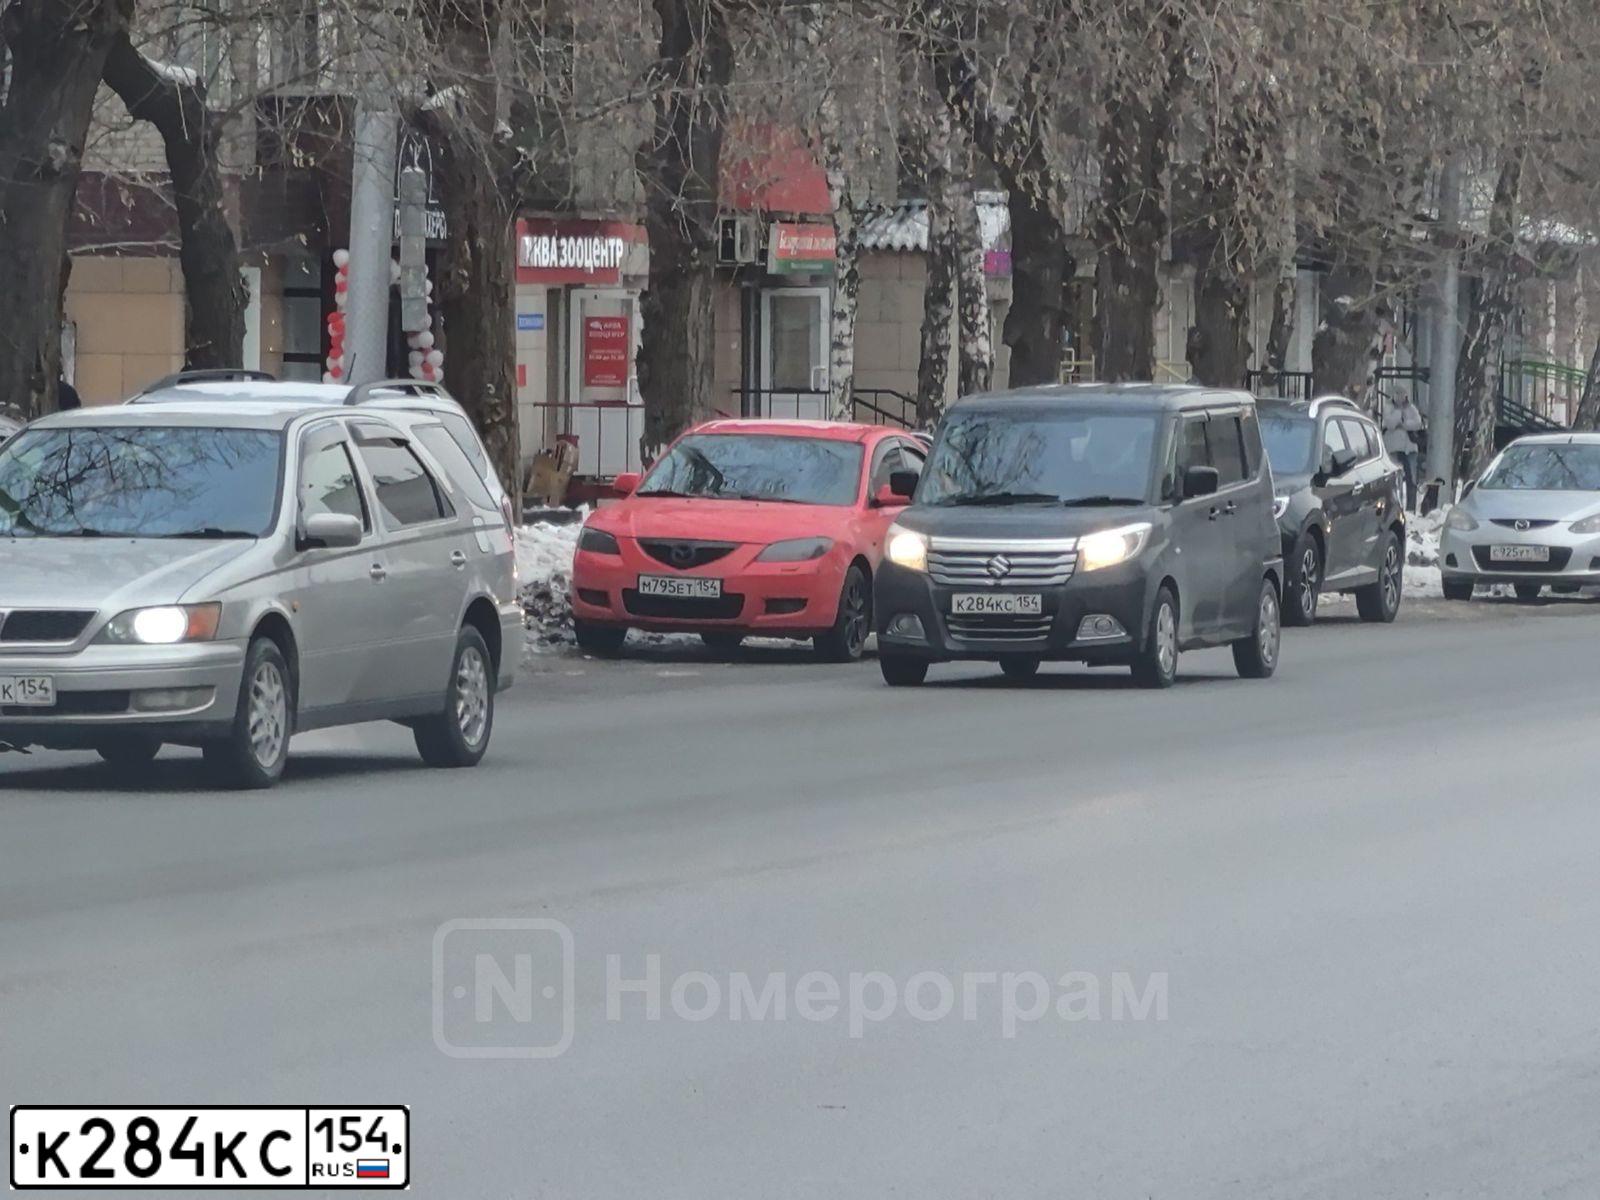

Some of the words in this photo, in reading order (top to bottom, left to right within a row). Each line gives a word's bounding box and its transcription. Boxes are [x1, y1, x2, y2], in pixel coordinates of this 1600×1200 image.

[642, 579, 693, 595] М795ЕТ
[697, 580, 717, 592] 154
[956, 596, 1013, 611] К284КС
[1016, 596, 1038, 608] 154
[18, 679, 49, 695] 154
